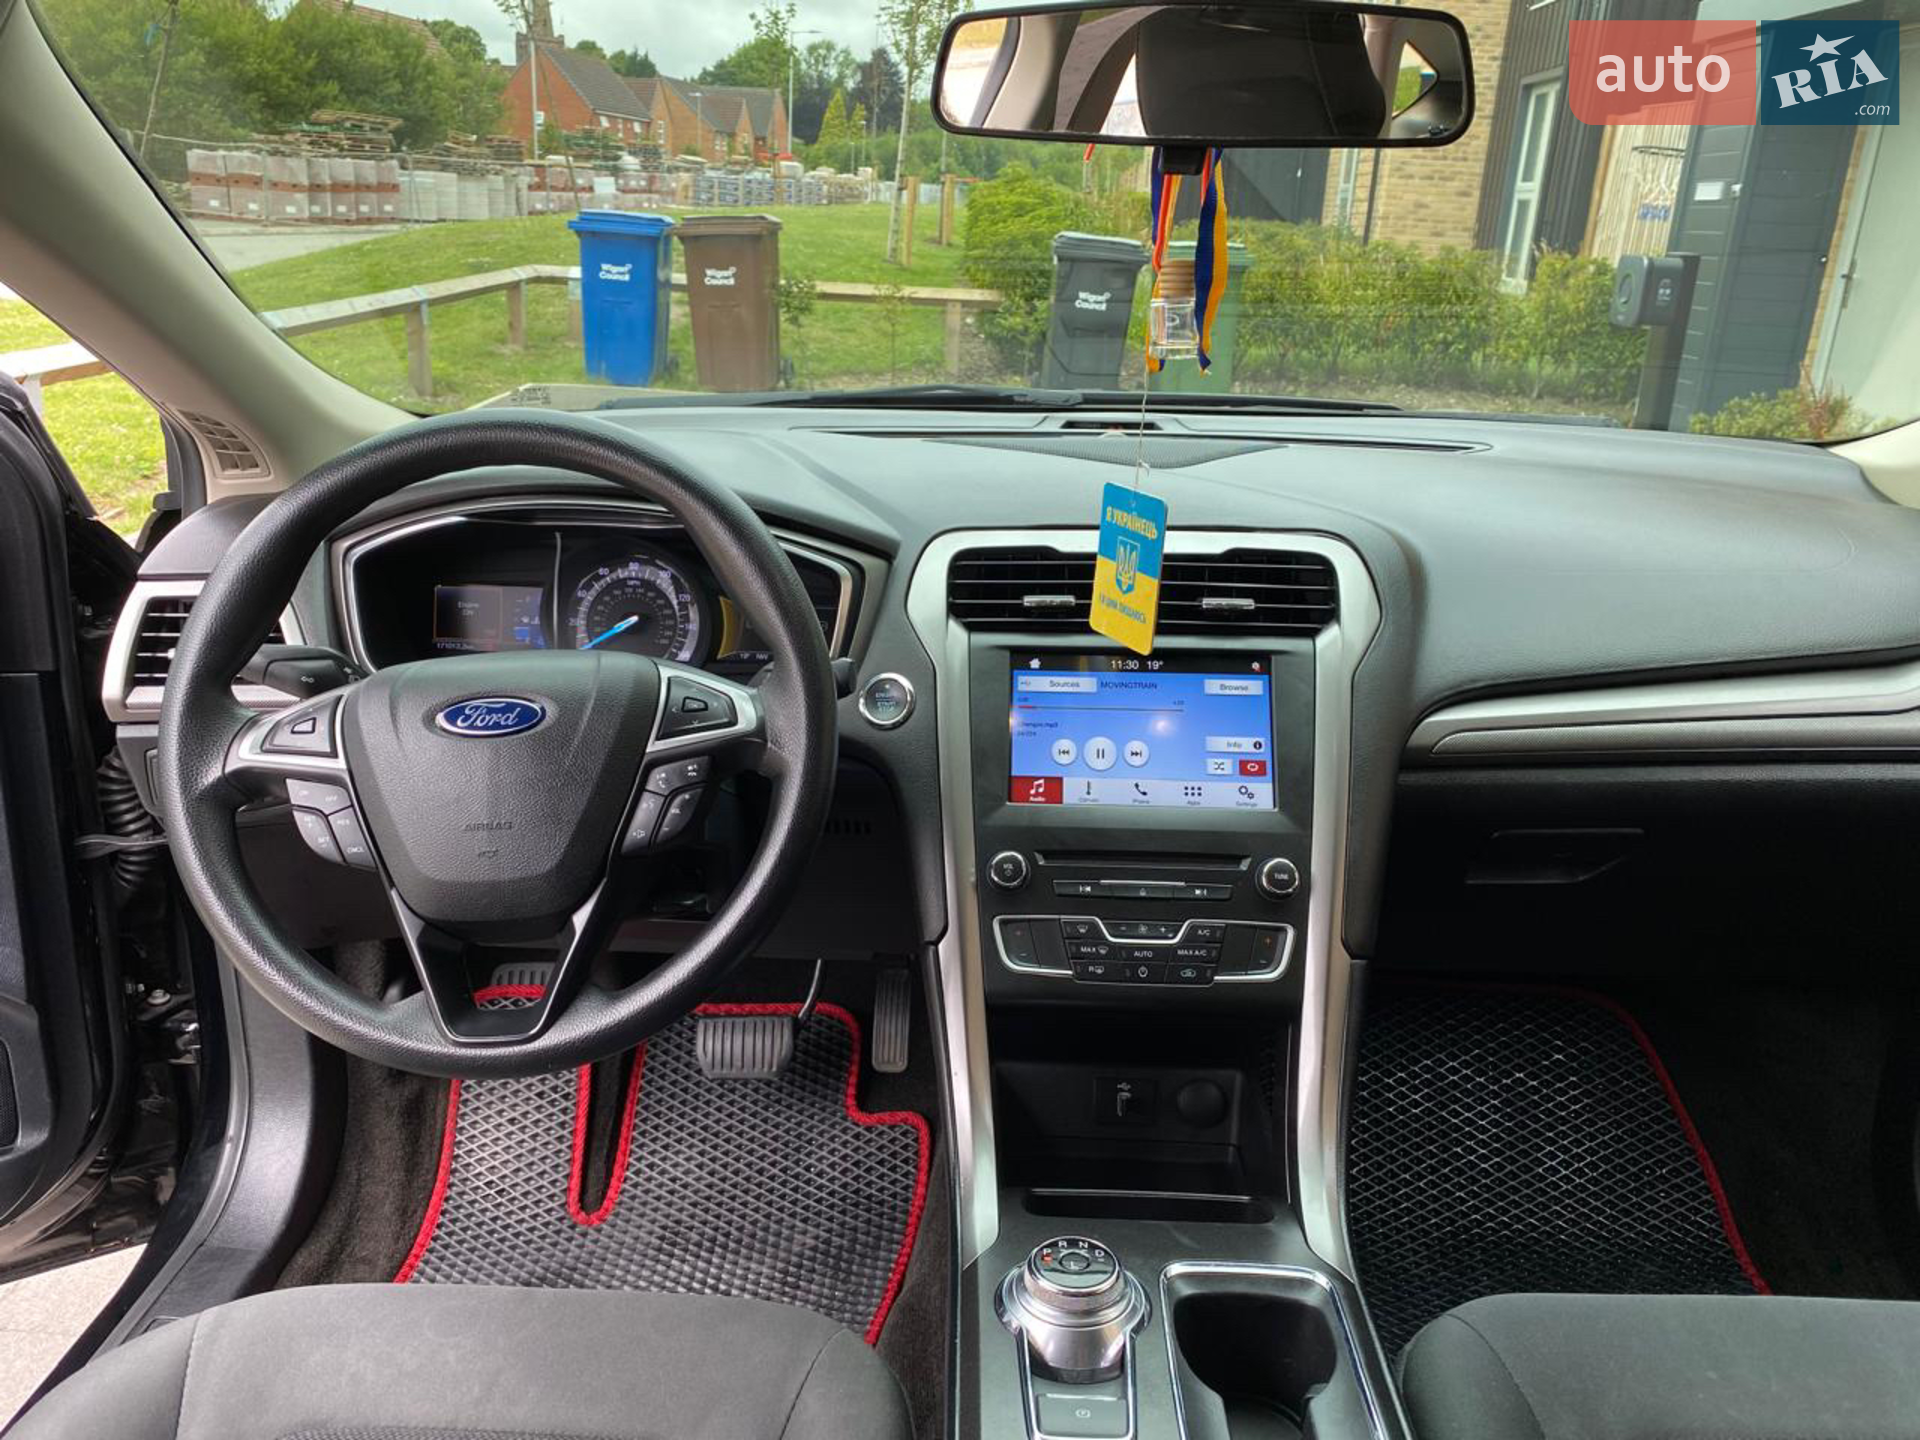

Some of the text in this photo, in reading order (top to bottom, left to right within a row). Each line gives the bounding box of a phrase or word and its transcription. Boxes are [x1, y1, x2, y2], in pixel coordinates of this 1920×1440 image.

[600, 264, 629, 274] Wigan
[705, 268, 733, 278] Wigan
[599, 272, 631, 282] Council
[704, 276, 735, 285] Council
[1078, 291, 1106, 302] Wigan
[1075, 300, 1107, 311] Council
[599, 567, 610, 575] 60
[628, 562, 640, 571] 80
[1111, 660, 1164, 670] 11:30 19°
[1049, 679, 1080, 688] Sources
[1100, 681, 1158, 690] MOVINGTRAIN
[457, 702, 521, 727] Ford
[1226, 741, 1242, 749] Info
[464, 821, 513, 833] AIRBAG
[1133, 950, 1153, 958] AUTO
[1078, 1241, 1089, 1249] N
[1043, 1247, 1052, 1255] P
[1094, 1249, 1105, 1257] D
